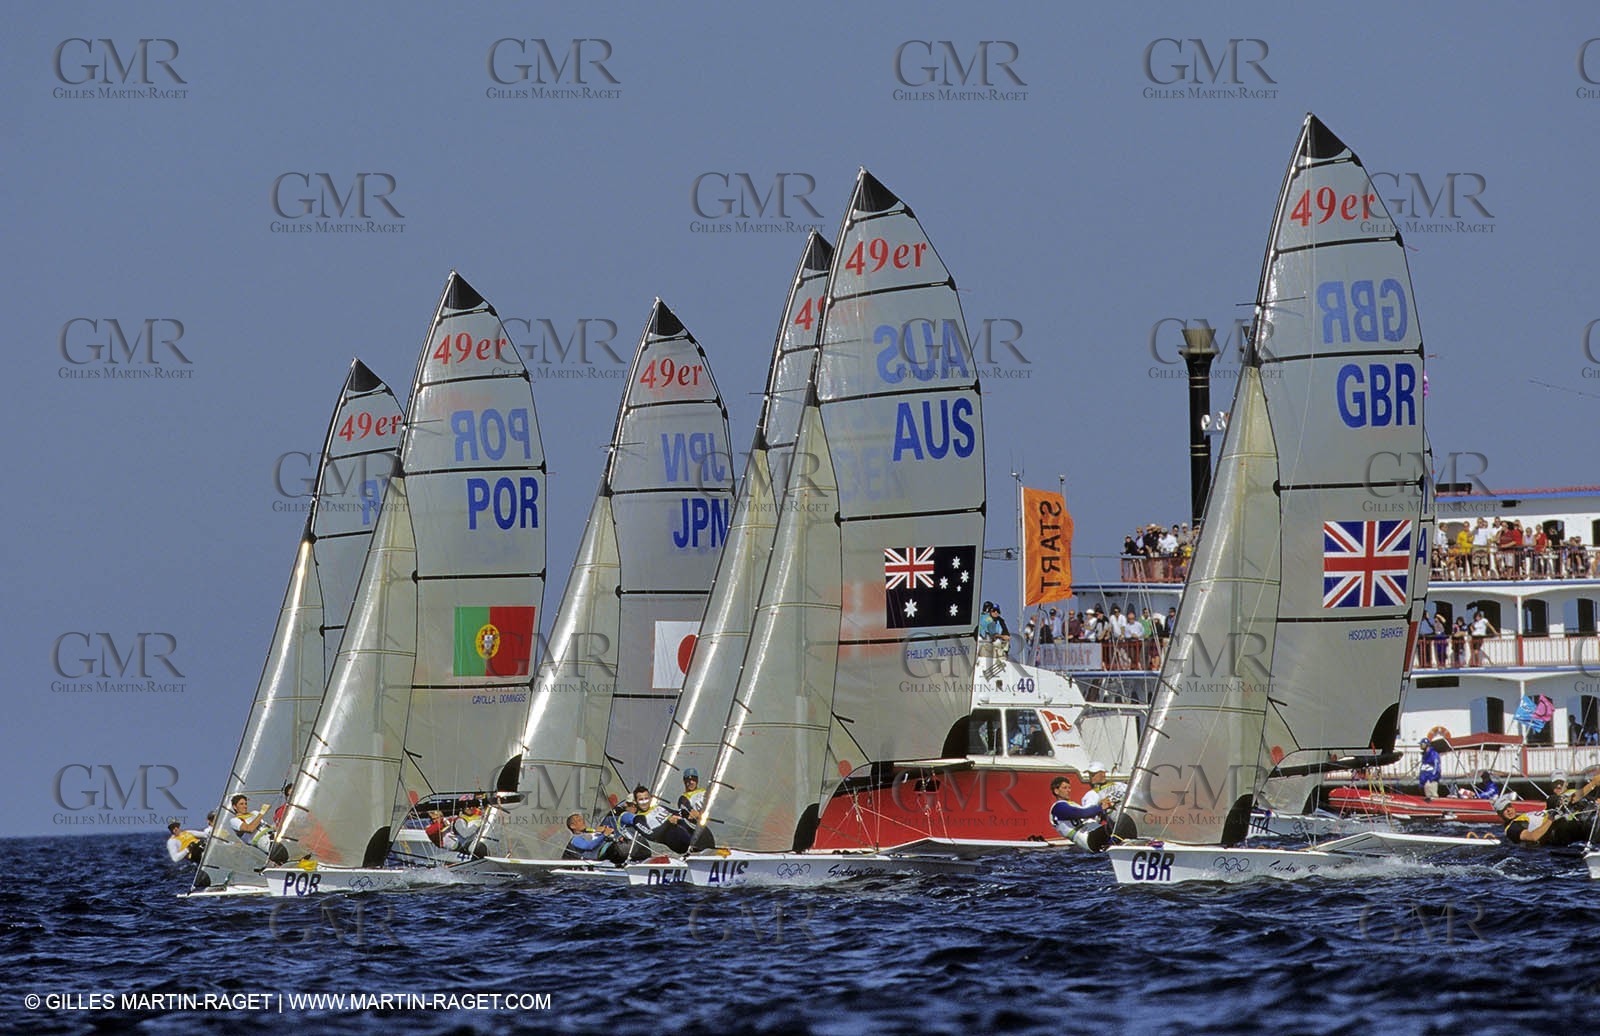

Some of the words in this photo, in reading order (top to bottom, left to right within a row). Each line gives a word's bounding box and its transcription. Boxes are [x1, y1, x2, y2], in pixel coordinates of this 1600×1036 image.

[1290, 187, 1375, 226] 49er
[845, 238, 927, 275] 49er
[433, 332, 508, 365] 49er
[640, 358, 703, 388] 49er
[1337, 363, 1416, 428] GBR
[339, 412, 402, 441] 49er
[893, 398, 975, 462] AUS
[466, 476, 539, 530] POR
[673, 498, 730, 549] JPN
[1017, 677, 1036, 694] 40
[283, 871, 321, 896] POR
[1131, 851, 1175, 882] GBR
